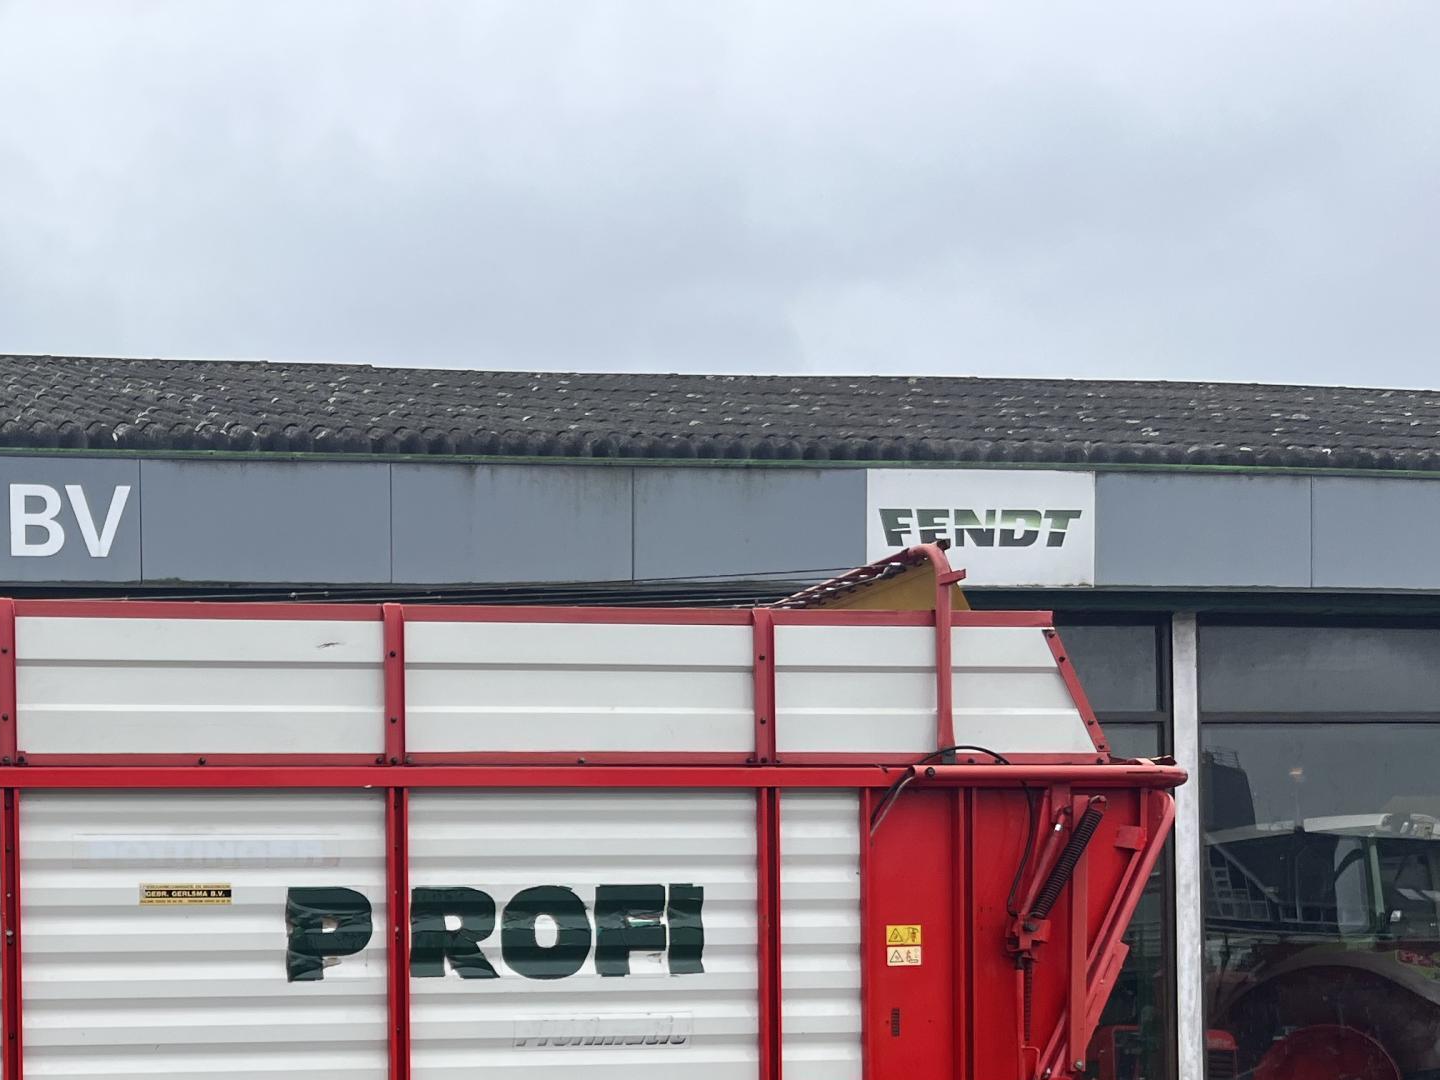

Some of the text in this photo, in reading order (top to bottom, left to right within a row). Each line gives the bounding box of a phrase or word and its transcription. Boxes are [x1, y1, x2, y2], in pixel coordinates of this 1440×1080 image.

[9, 483, 131, 559] BV
[878, 508, 1083, 547] FENDT
[285, 884, 704, 982] PROFI
